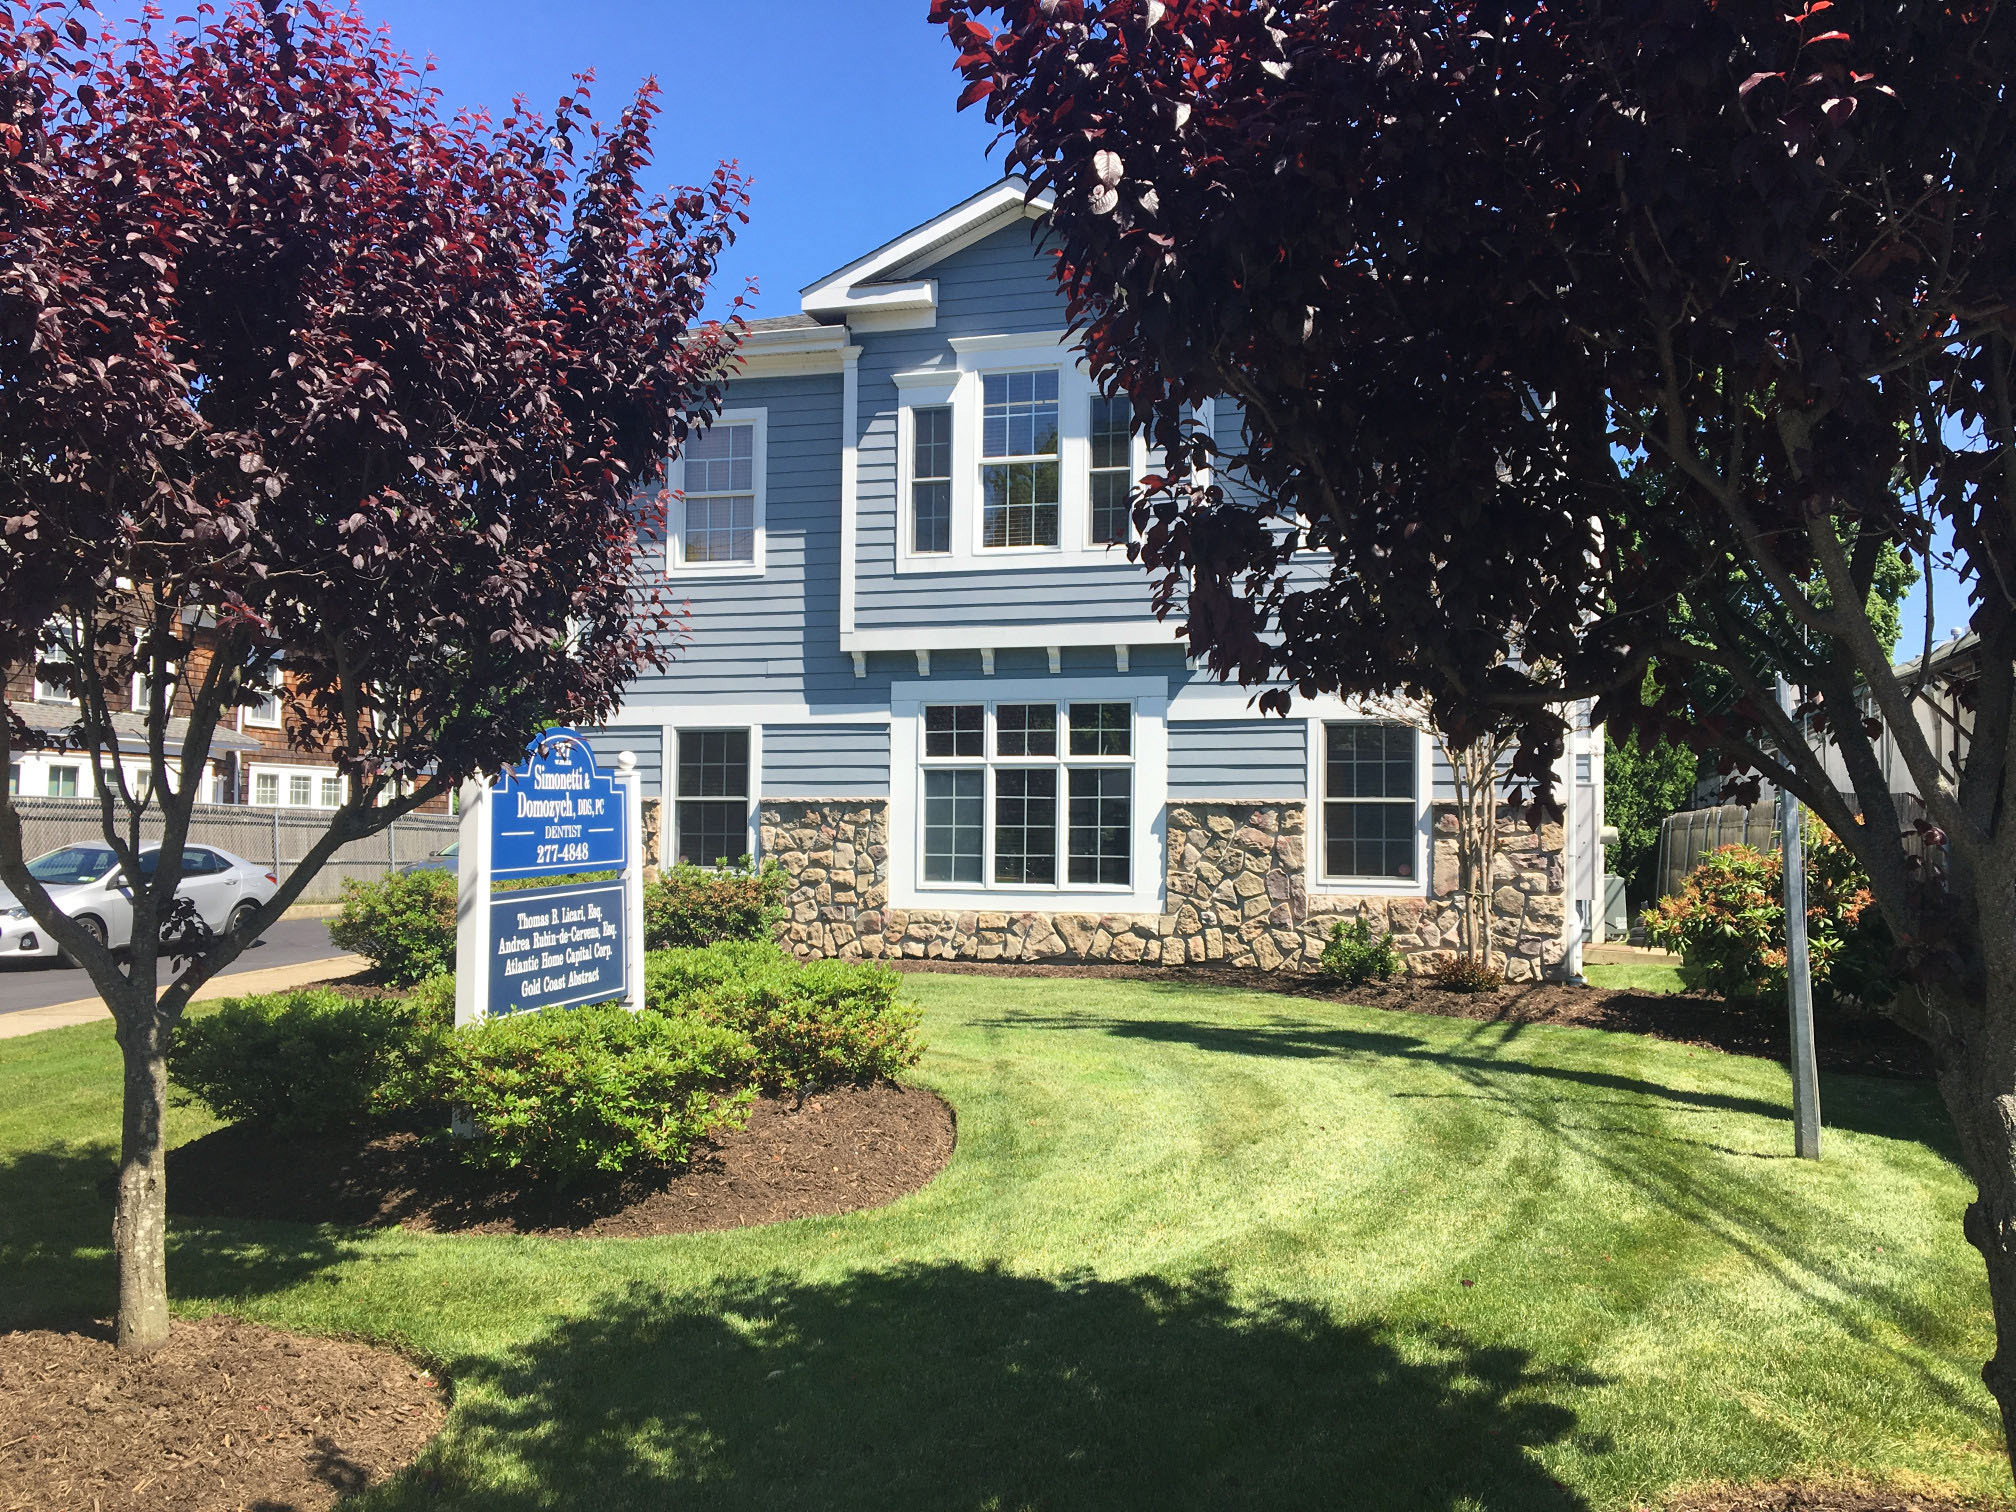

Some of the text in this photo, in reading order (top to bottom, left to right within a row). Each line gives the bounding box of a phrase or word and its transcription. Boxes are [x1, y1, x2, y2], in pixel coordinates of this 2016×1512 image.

[534, 765, 590, 790] Simonetti &
[517, 792, 604, 823] Domozych, DDS, PC
[545, 825, 582, 839] DENTIST
[536, 842, 589, 863] 277-4848
[517, 903, 603, 930] Thomas B. Licari, Esq.
[498, 936, 530, 955] Andrea
[602, 921, 617, 939] Esq.
[504, 943, 613, 976] Atlantic Home Capital Corp.
[521, 967, 599, 997] Gold Coast Abstract
